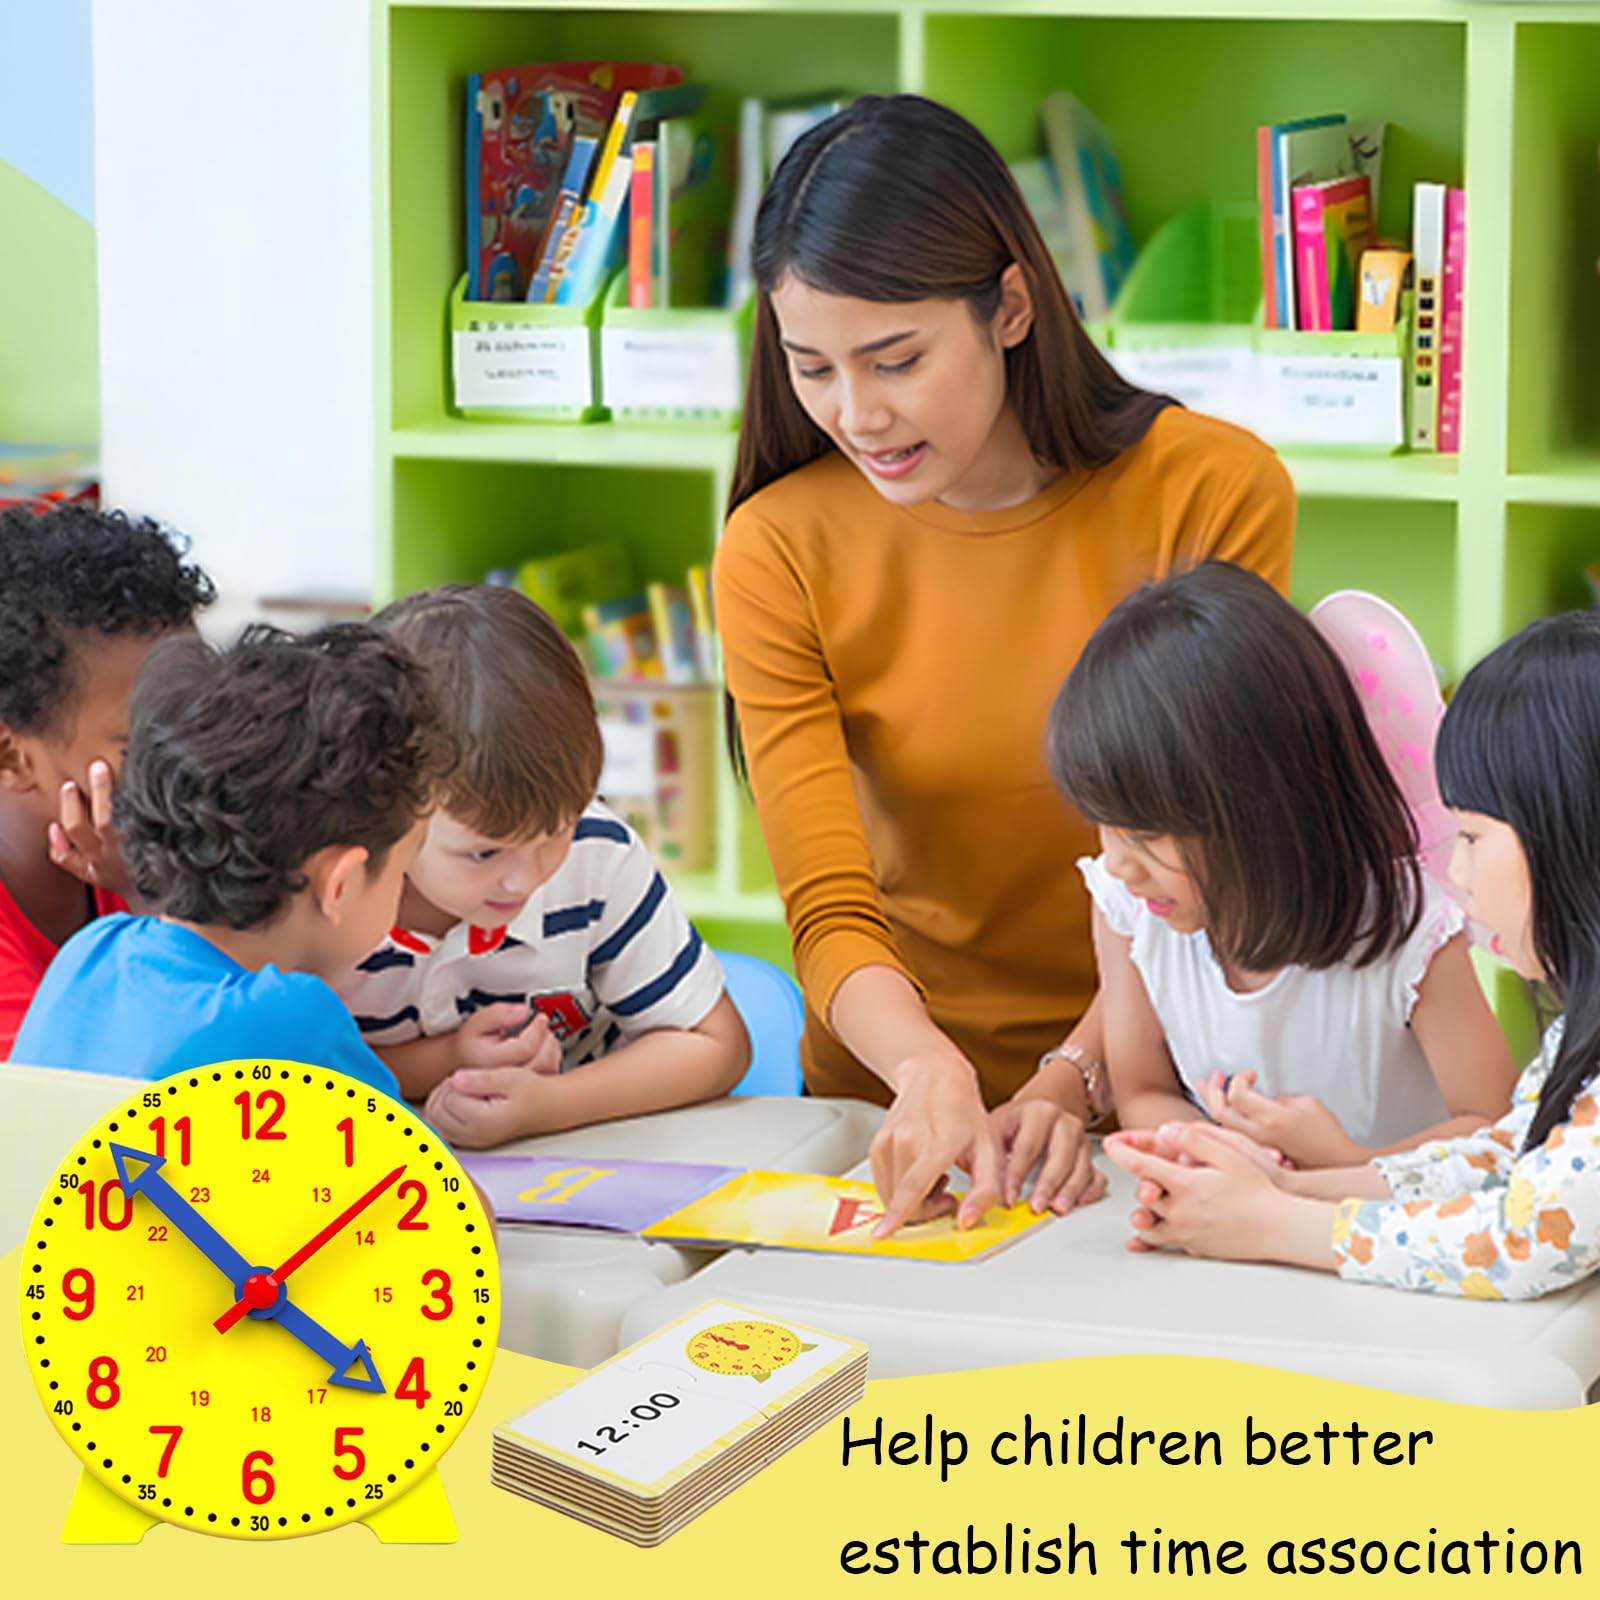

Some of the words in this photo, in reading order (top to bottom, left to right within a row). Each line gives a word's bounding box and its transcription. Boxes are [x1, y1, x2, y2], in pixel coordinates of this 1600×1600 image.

[252, 1065, 272, 1080] 60
[142, 1093, 161, 1108] 55
[367, 1098, 377, 1113] 5
[233, 1089, 288, 1141] 12
[148, 1115, 191, 1167] 11
[335, 1116, 354, 1168] 1
[59, 1173, 79, 1189] 50
[252, 1168, 271, 1183] 24
[442, 1177, 459, 1193] 10
[516, 1165, 618, 1204] B
[189, 1186, 211, 1203] 23
[312, 1187, 332, 1204] 13
[77, 1178, 134, 1232] 10
[395, 1179, 430, 1231] 2
[147, 1225, 168, 1242] 22
[355, 1230, 376, 1246] 14
[25, 1284, 45, 1300] 45
[61, 1267, 96, 1322] 9
[126, 1284, 144, 1301] 21
[373, 1287, 393, 1304] 15
[420, 1268, 454, 1322] 3
[473, 1288, 490, 1304] 15
[145, 1345, 167, 1363] 20
[86, 1355, 121, 1411] 8
[393, 1356, 432, 1410] 4
[190, 1390, 210, 1407] 19
[307, 1388, 328, 1405] 17
[53, 1399, 74, 1416] 40
[251, 1406, 272, 1423] 18
[444, 1400, 463, 1417] 20
[577, 1392, 681, 1456] 12:00
[148, 1425, 184, 1479] 7
[332, 1426, 366, 1481] 5
[241, 1449, 276, 1506] 6
[137, 1484, 157, 1500] 35
[364, 1483, 384, 1500] 25
[250, 1515, 270, 1532] 30
